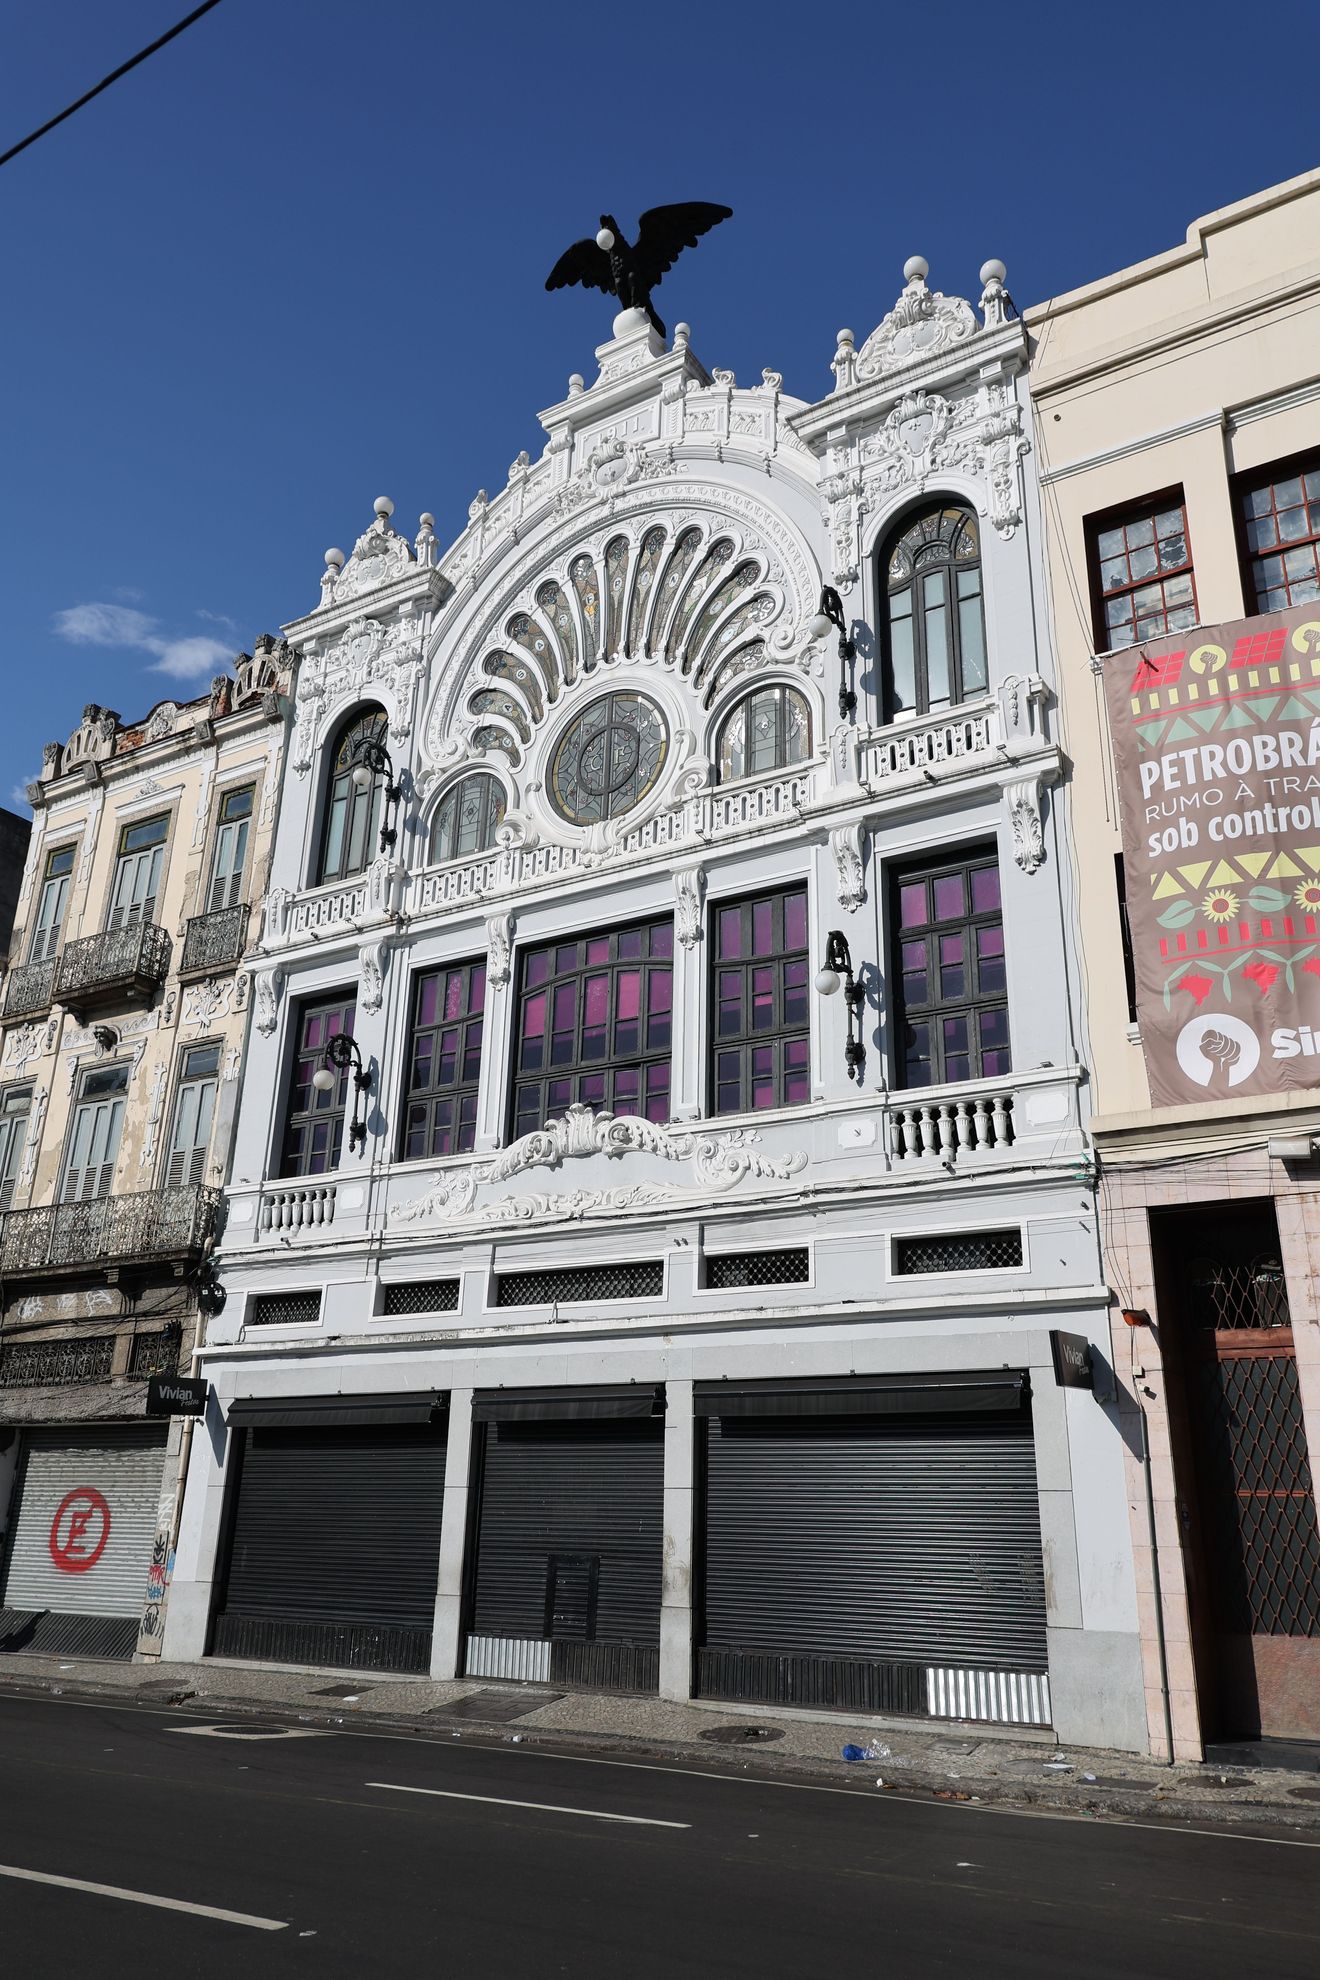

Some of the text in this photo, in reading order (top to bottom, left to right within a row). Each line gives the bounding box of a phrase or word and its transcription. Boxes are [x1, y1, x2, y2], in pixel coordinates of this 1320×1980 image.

[1145, 788, 1224, 824] RUMO
[1234, 779, 1255, 800] À
[1148, 796, 1320, 857] sob control
[1062, 1343, 1085, 1367] Vivian
[158, 1385, 193, 1400] Vivian
